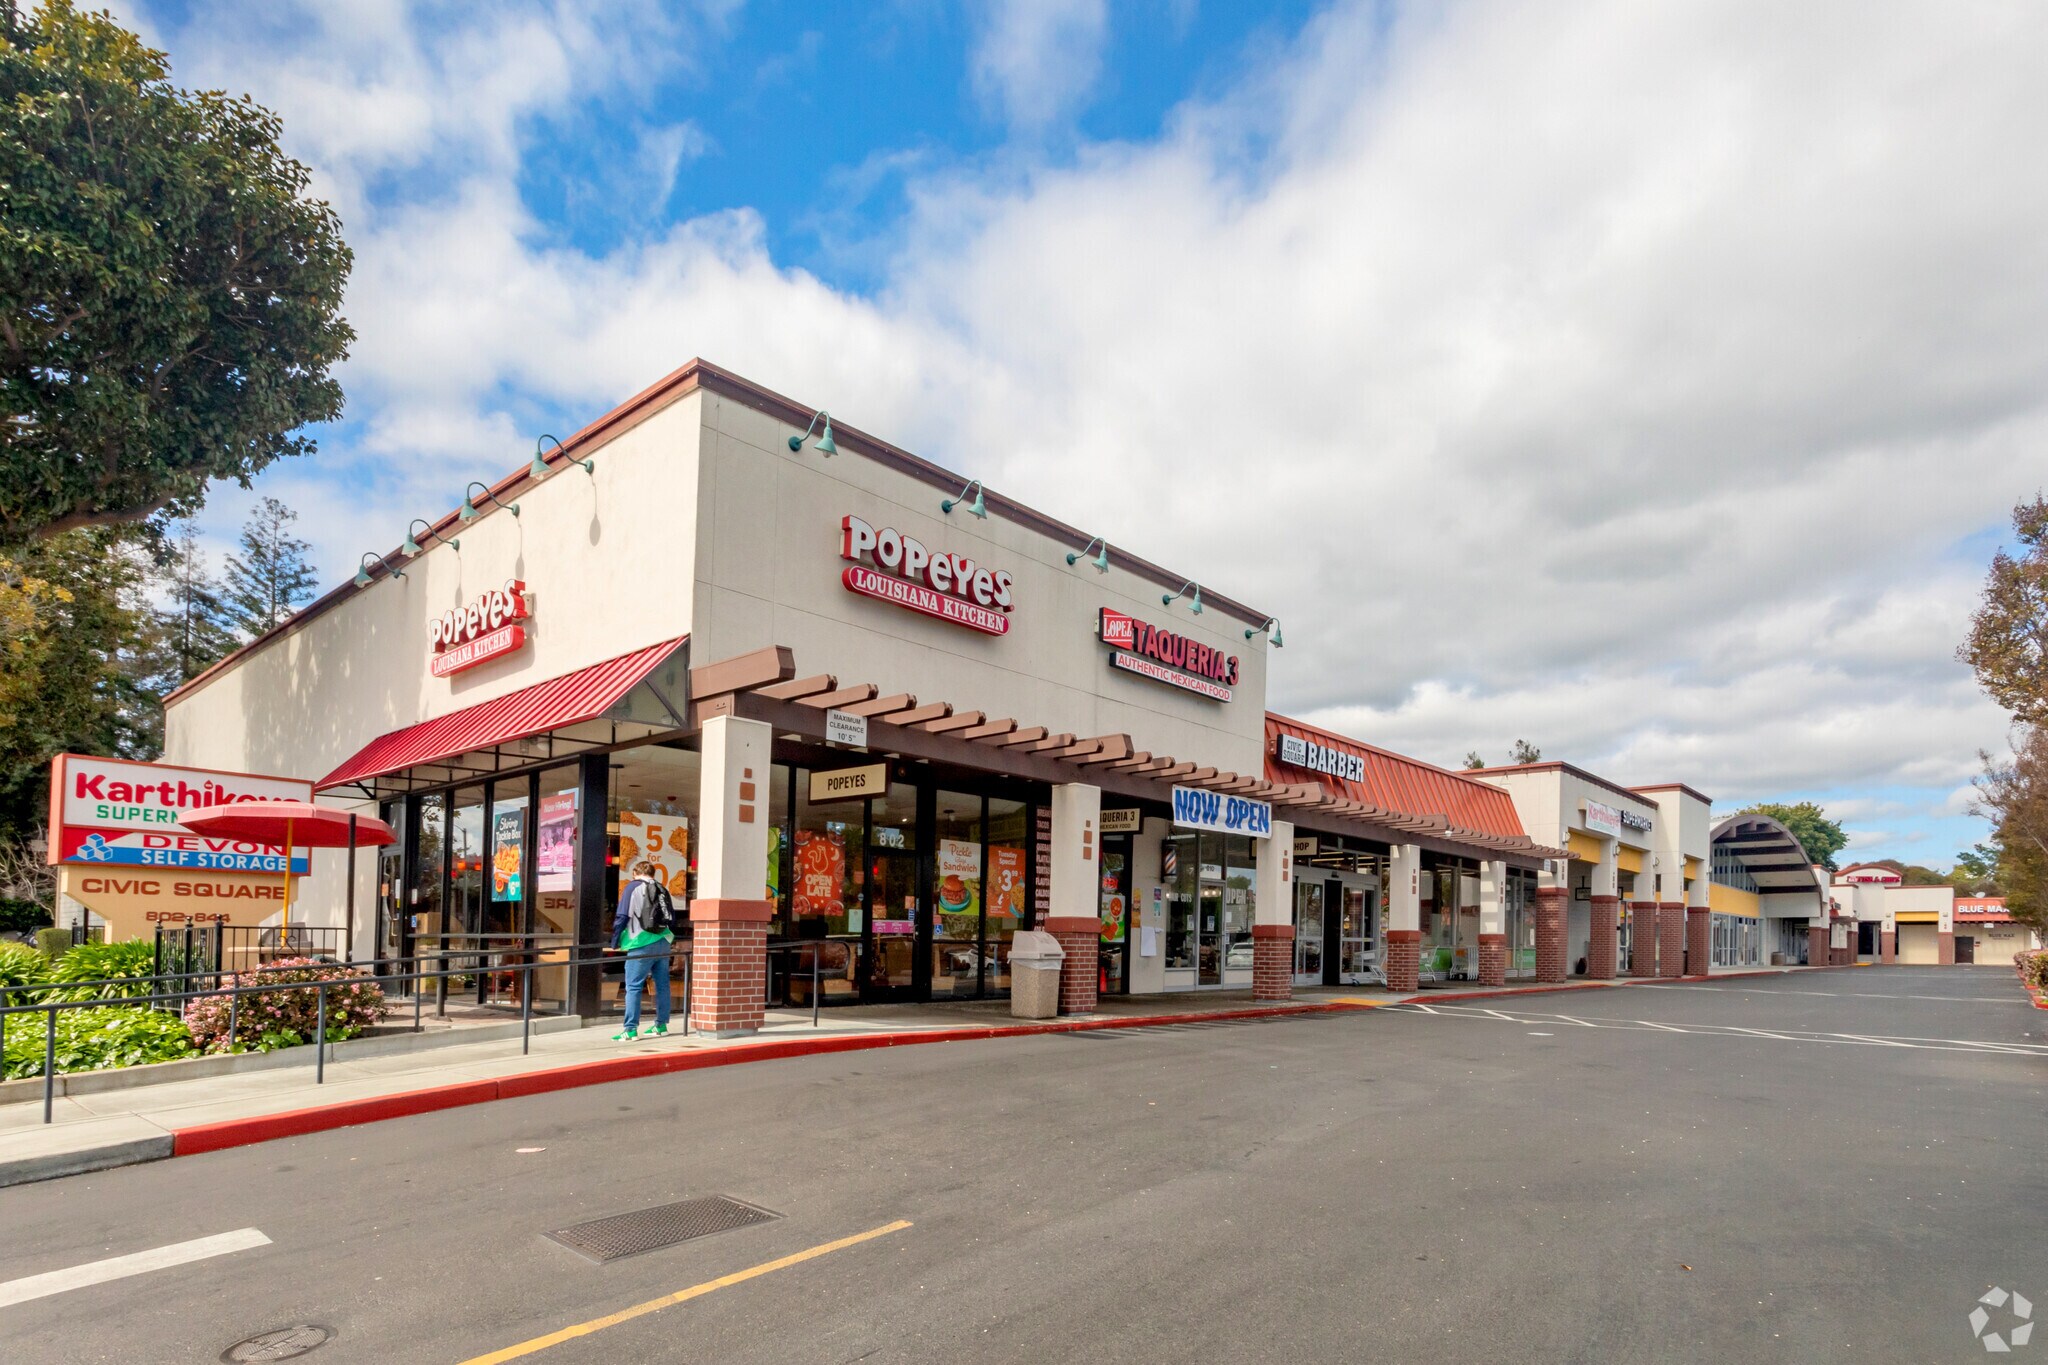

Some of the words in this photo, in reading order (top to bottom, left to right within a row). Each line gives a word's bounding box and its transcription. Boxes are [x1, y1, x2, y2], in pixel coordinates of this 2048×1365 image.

[856, 570, 938, 611] LOUISIANA
[943, 600, 1005, 631] KITCHEN
[1103, 617, 1132, 638] LOPEZ
[433, 645, 473, 674] LOUISIANA
[474, 629, 511, 658] KITCHEN
[1132, 619, 1227, 683] TAQUERIA
[1227, 656, 1239, 685] 3
[1118, 655, 1169, 680] AUTHENTIC
[1171, 672, 1208, 692] MEXICAN
[1209, 685, 1230, 700] FOOD
[829, 721, 864, 734] CLEARANCE
[833, 713, 861, 725] MAXIMUM
[1286, 740, 1302, 753] CIVIC
[1283, 750, 1305, 764] SQUARE
[1307, 741, 1365, 783] BARBER
[75, 772, 301, 808] Karthik
[827, 774, 866, 791] POPEYES
[1100, 811, 1128, 823] QUERIA
[1130, 811, 1135, 821] 3
[1175, 789, 1221, 826] NOW
[1225, 797, 1270, 834] OPEN
[142, 834, 287, 856] DEVON
[646, 825, 663, 852] 5
[879, 833, 905, 848] 802
[1294, 842, 1310, 851] HOP
[141, 850, 189, 866] SELF
[198, 853, 287, 871] STORAGE
[646, 853, 662, 862] for
[943, 861, 978, 873] Sandwich
[81, 878, 161, 895] CIVIC
[173, 882, 286, 900] SQUARE
[805, 874, 833, 887] OPEN
[806, 885, 832, 897] LATE
[1226, 887, 1247, 905] OPEN
[145, 911, 231, 923] 802-844
[1957, 905, 1984, 913] BLUE
